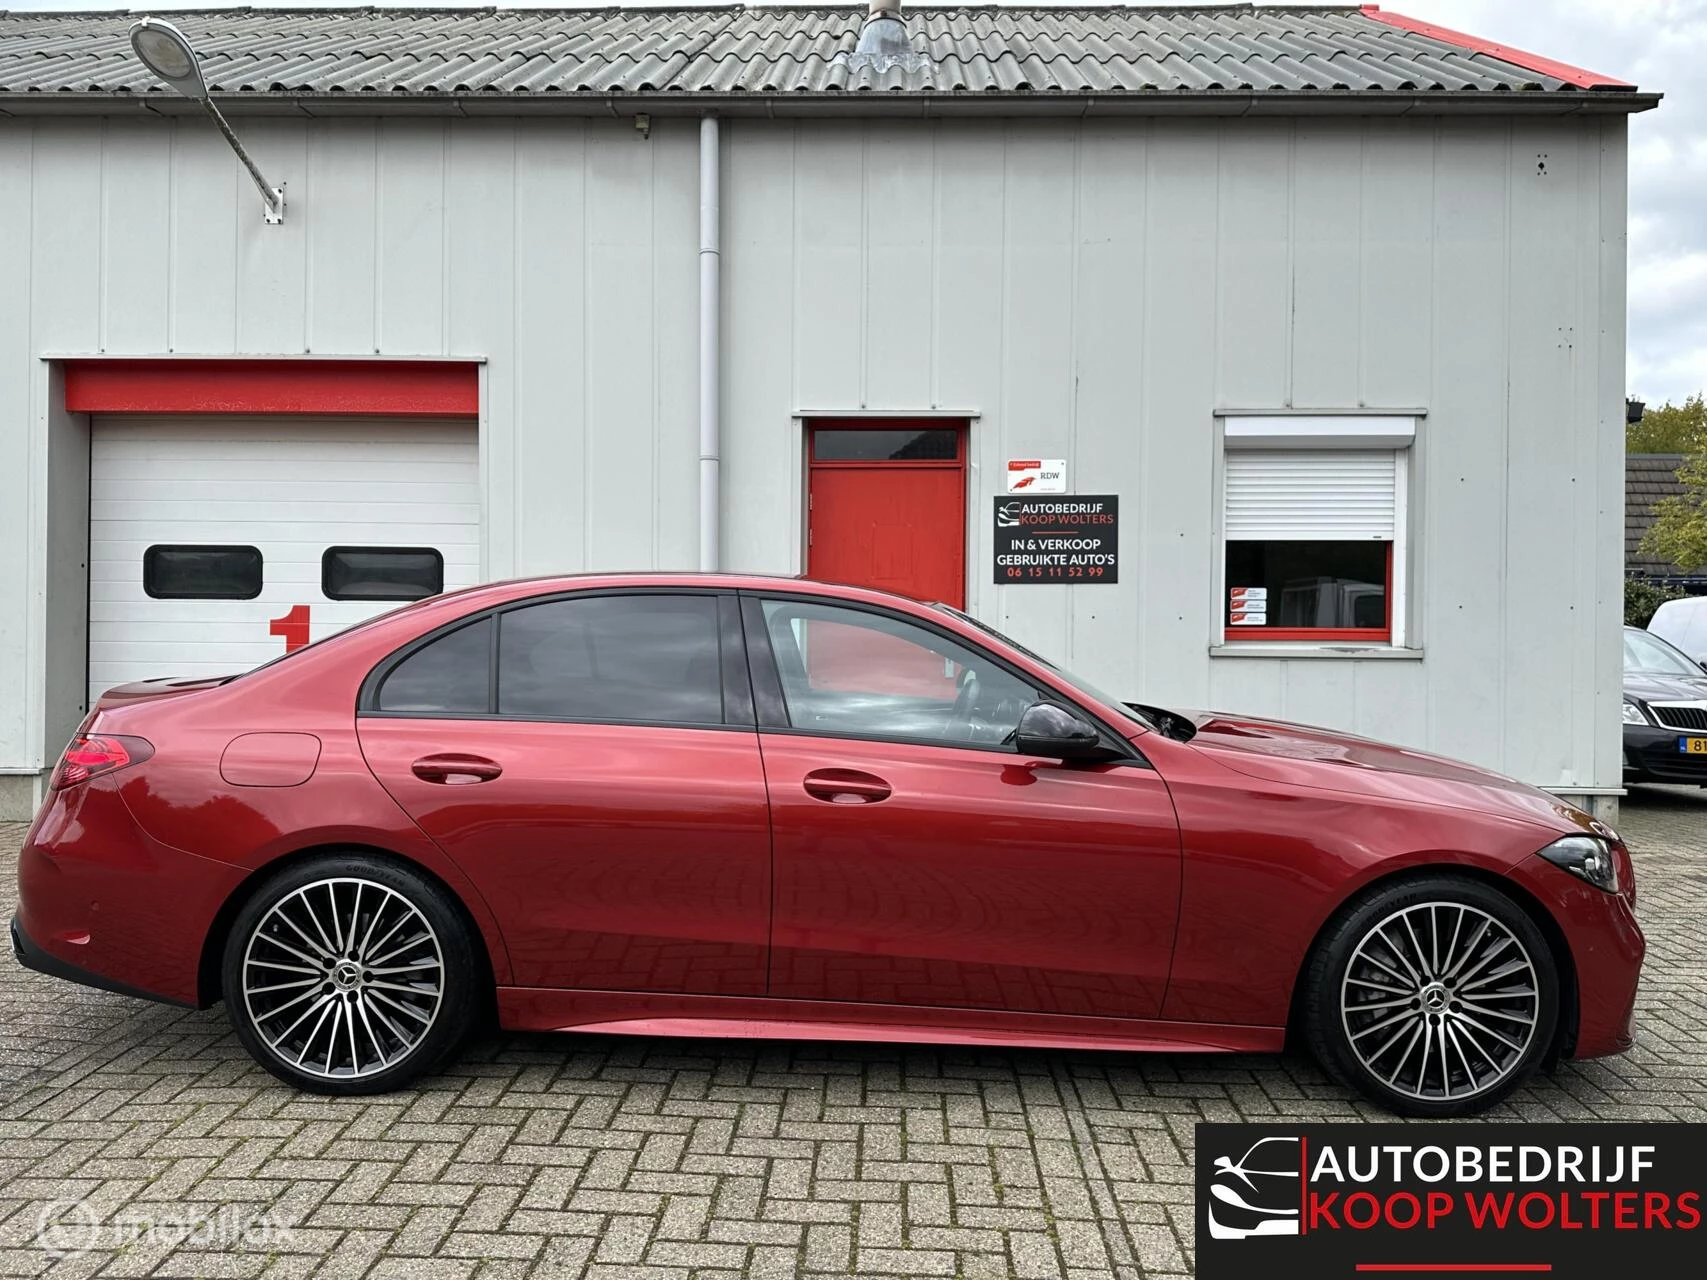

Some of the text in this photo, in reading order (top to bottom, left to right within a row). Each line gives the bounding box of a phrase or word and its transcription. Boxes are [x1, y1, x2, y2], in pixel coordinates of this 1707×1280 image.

[1040, 472, 1060, 480] RDW
[1021, 503, 1103, 514] AUTOBEDRIJF
[1021, 514, 1114, 525] KOOP WOLTERS
[1011, 539, 1101, 550] IN & VERKOOP
[997, 554, 1115, 565] GEBRUIKTE AUTO'S
[1007, 567, 1103, 577] 06 15 11 52 99
[270, 605, 310, 654] 1
